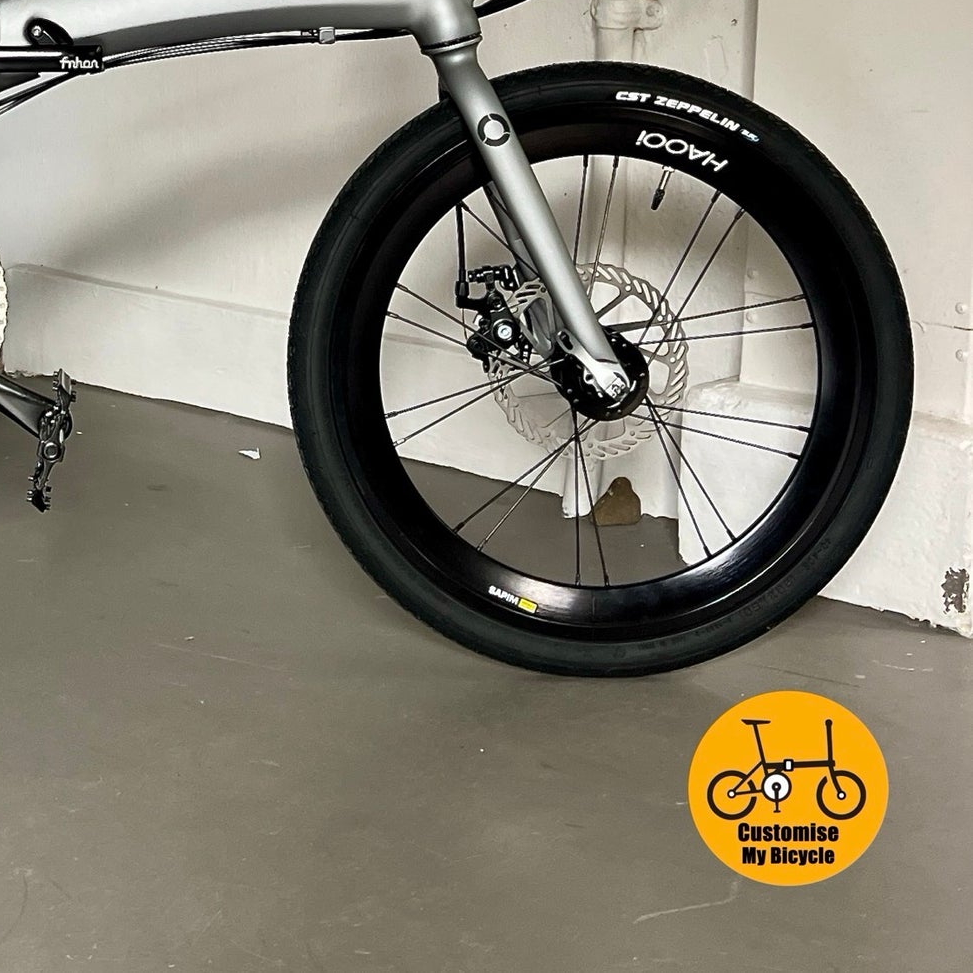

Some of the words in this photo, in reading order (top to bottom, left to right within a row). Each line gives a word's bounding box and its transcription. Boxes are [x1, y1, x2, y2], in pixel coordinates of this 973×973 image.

[59, 57, 100, 70] fnhon
[615, 90, 651, 103] CST
[653, 95, 741, 132] ZEPPELIN
